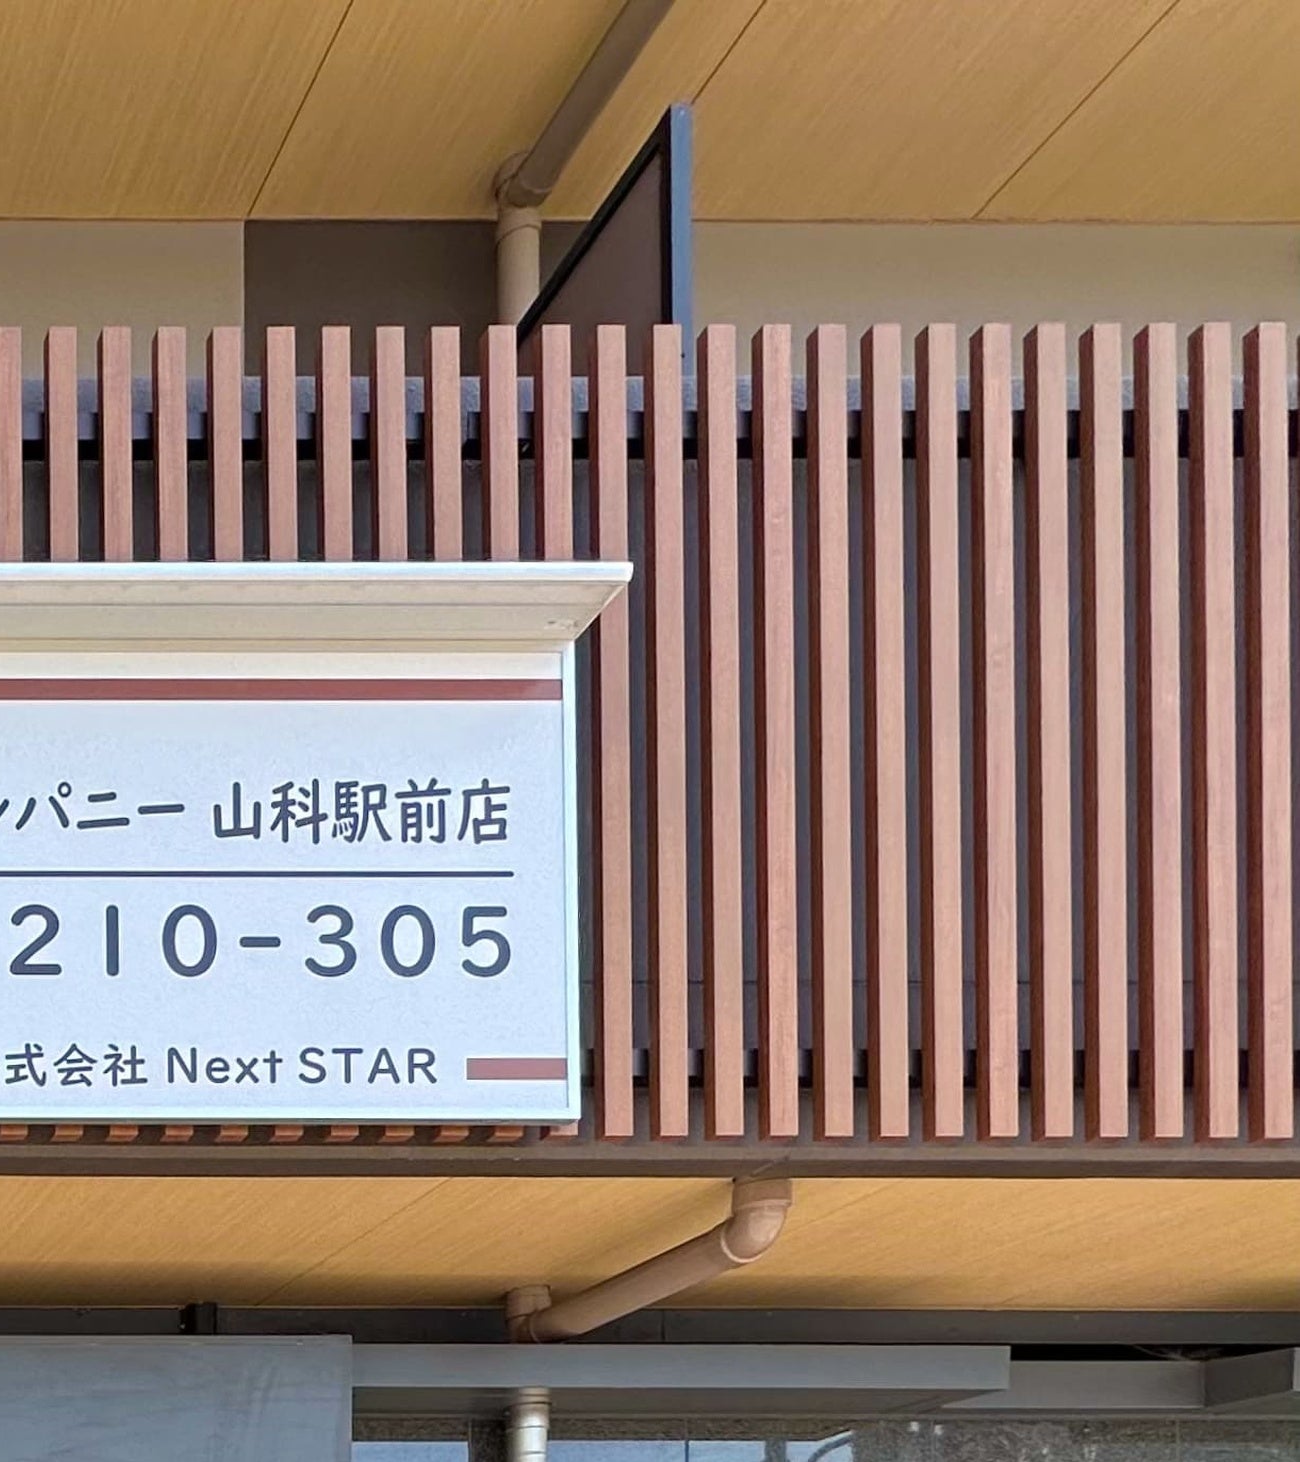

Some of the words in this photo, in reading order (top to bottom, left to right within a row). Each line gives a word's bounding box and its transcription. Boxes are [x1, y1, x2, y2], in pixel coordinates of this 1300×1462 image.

[214, 778, 510, 844] 山科駅前店
[168, 1046, 284, 1084] Next
[298, 1046, 438, 1085] STAR
